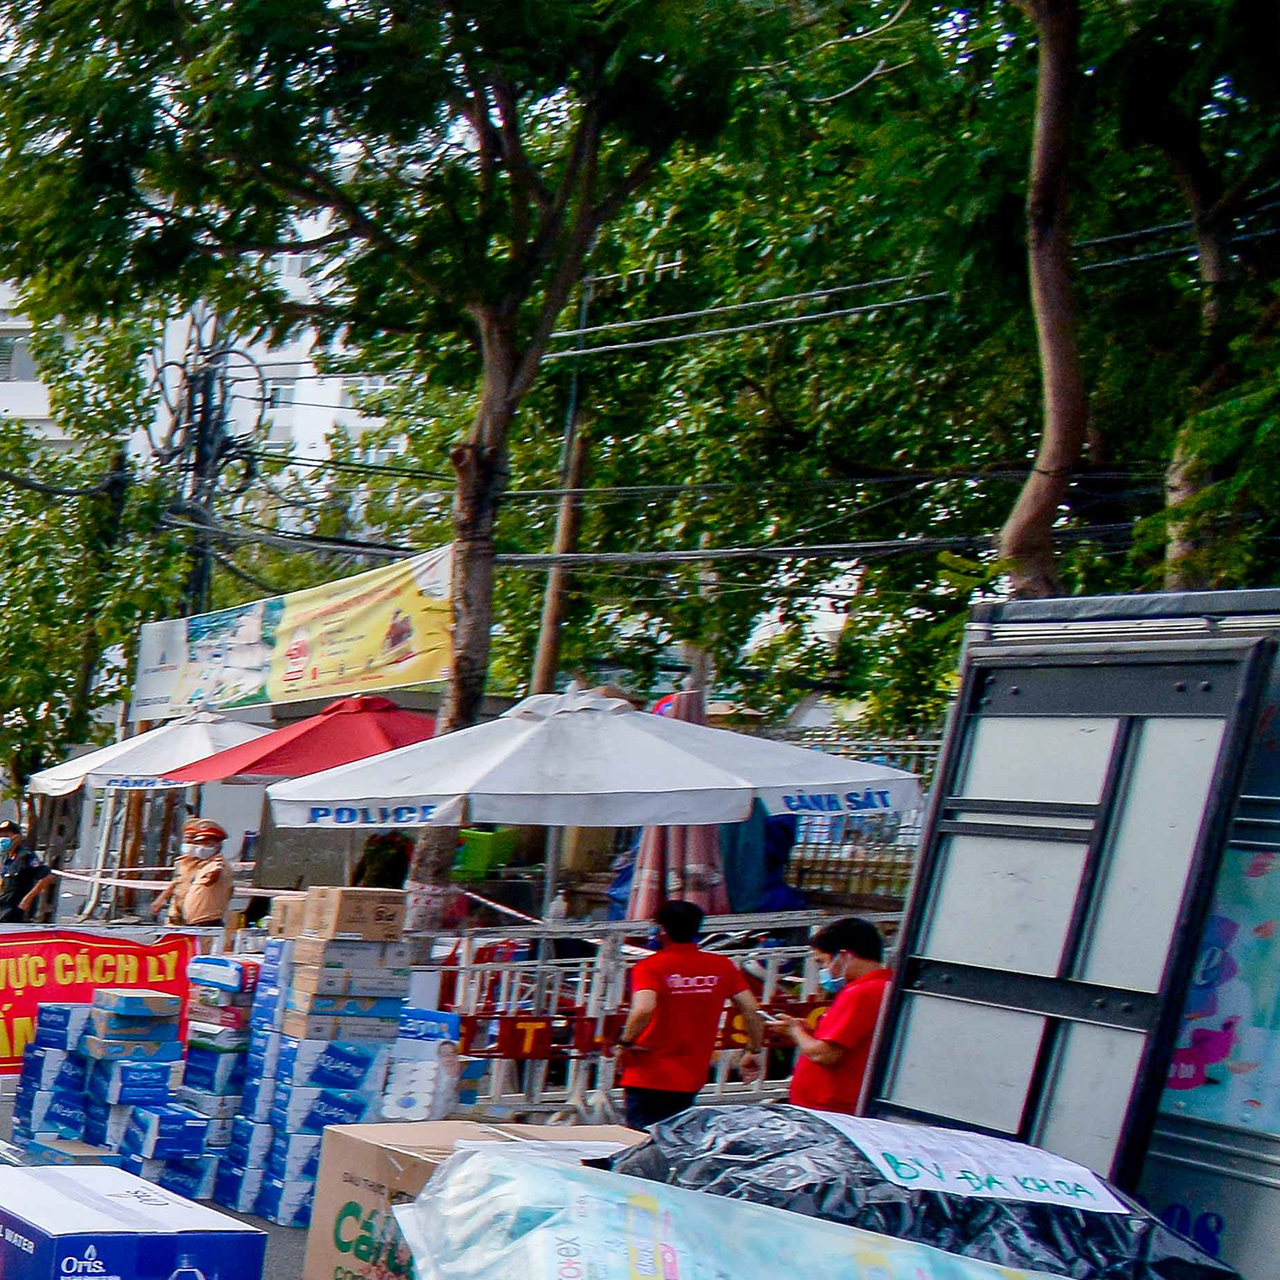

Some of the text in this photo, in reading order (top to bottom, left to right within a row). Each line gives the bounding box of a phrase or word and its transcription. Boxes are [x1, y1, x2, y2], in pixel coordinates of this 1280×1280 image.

[308, 803, 441, 826] POLICE
[54, 943, 139, 986] CÁCH
[147, 949, 178, 983] LY
[515, 1021, 552, 1055] T
[880, 1151, 945, 1183] BV
[1014, 1172, 1096, 1200] KHOA
[4, 1229, 36, 1256] WATER
